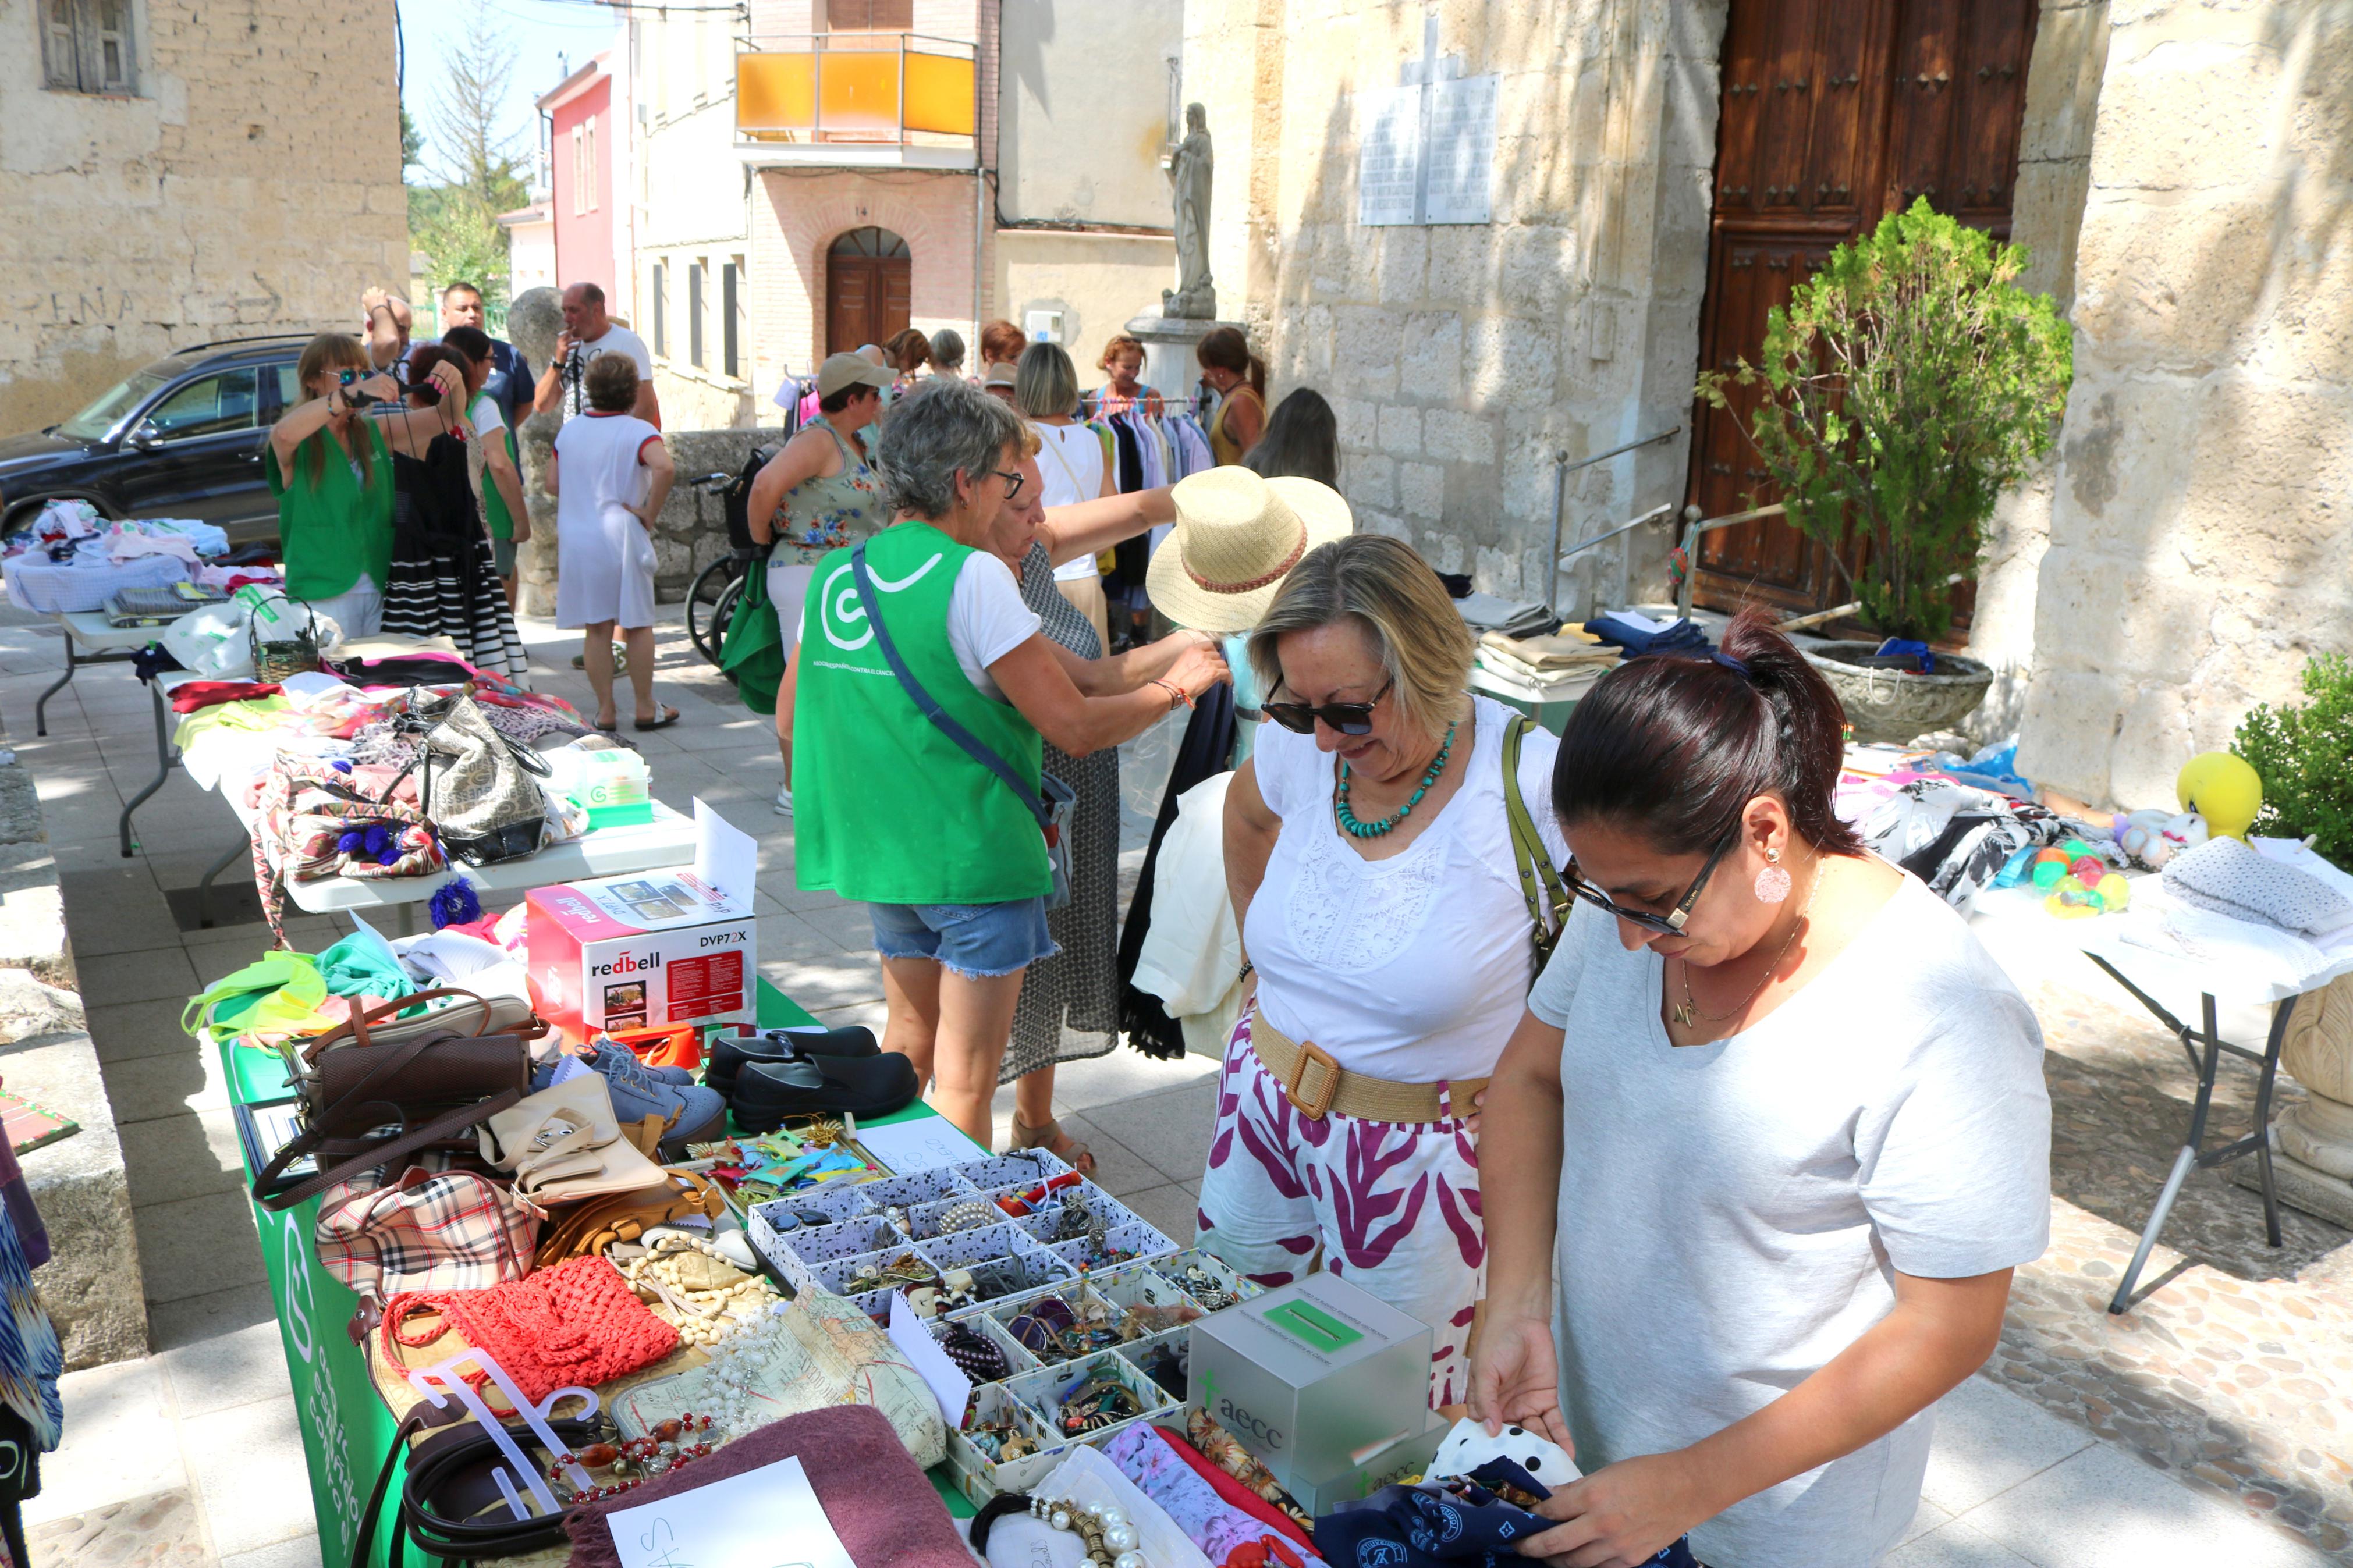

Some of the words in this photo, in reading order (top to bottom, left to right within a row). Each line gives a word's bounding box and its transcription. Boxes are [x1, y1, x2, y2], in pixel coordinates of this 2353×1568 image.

[700, 931, 746, 948] DVP72X
[592, 950, 660, 977] redbell
[1220, 1396, 1282, 1449] aecc
[1373, 1460, 1414, 1491] aecc
